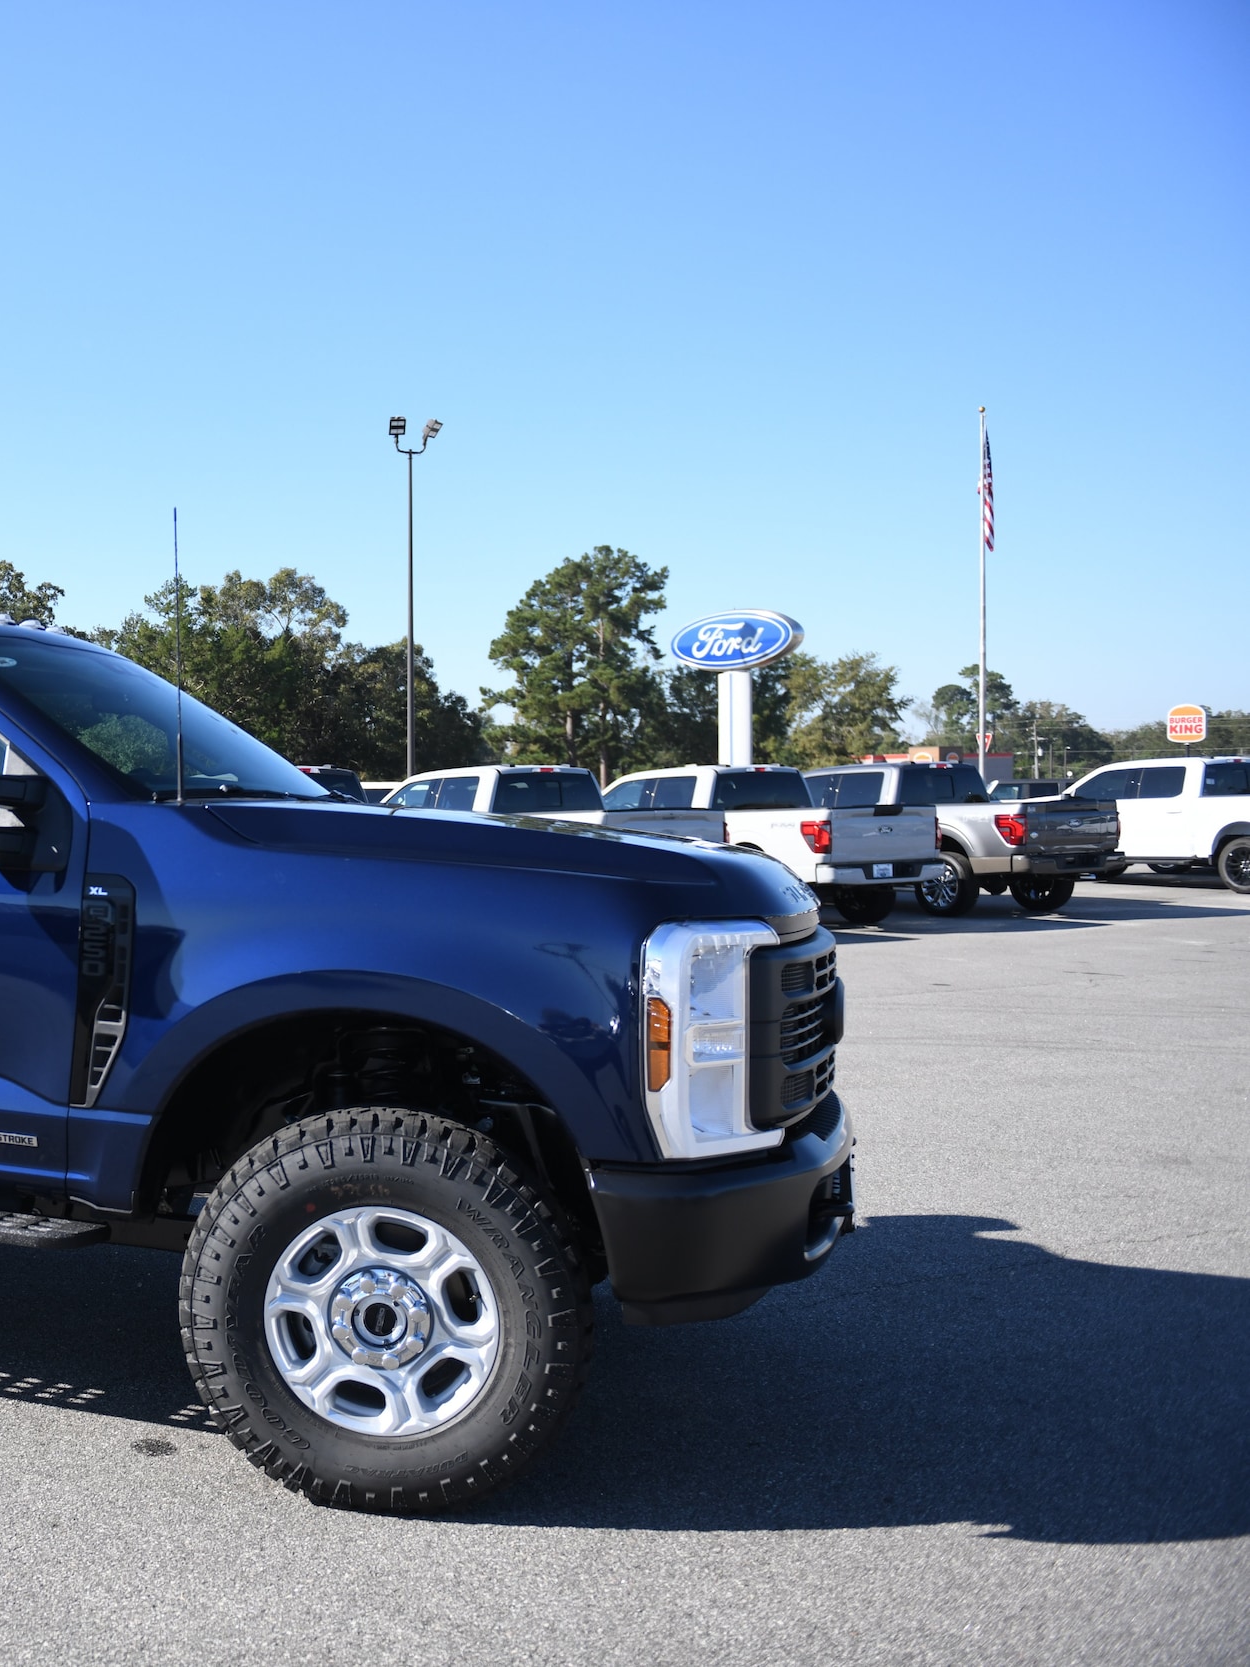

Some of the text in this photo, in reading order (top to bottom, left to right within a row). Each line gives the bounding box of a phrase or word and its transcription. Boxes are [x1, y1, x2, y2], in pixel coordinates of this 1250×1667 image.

[691, 621, 765, 659] Ford
[1169, 716, 1203, 724] BURGER
[1169, 724, 1203, 734] KING
[88, 886, 109, 896] XL
[456, 1198, 542, 1427] WRANGLER
[224, 1224, 311, 1450] GOODYEAR
[343, 1450, 469, 1480] DURATRAC
